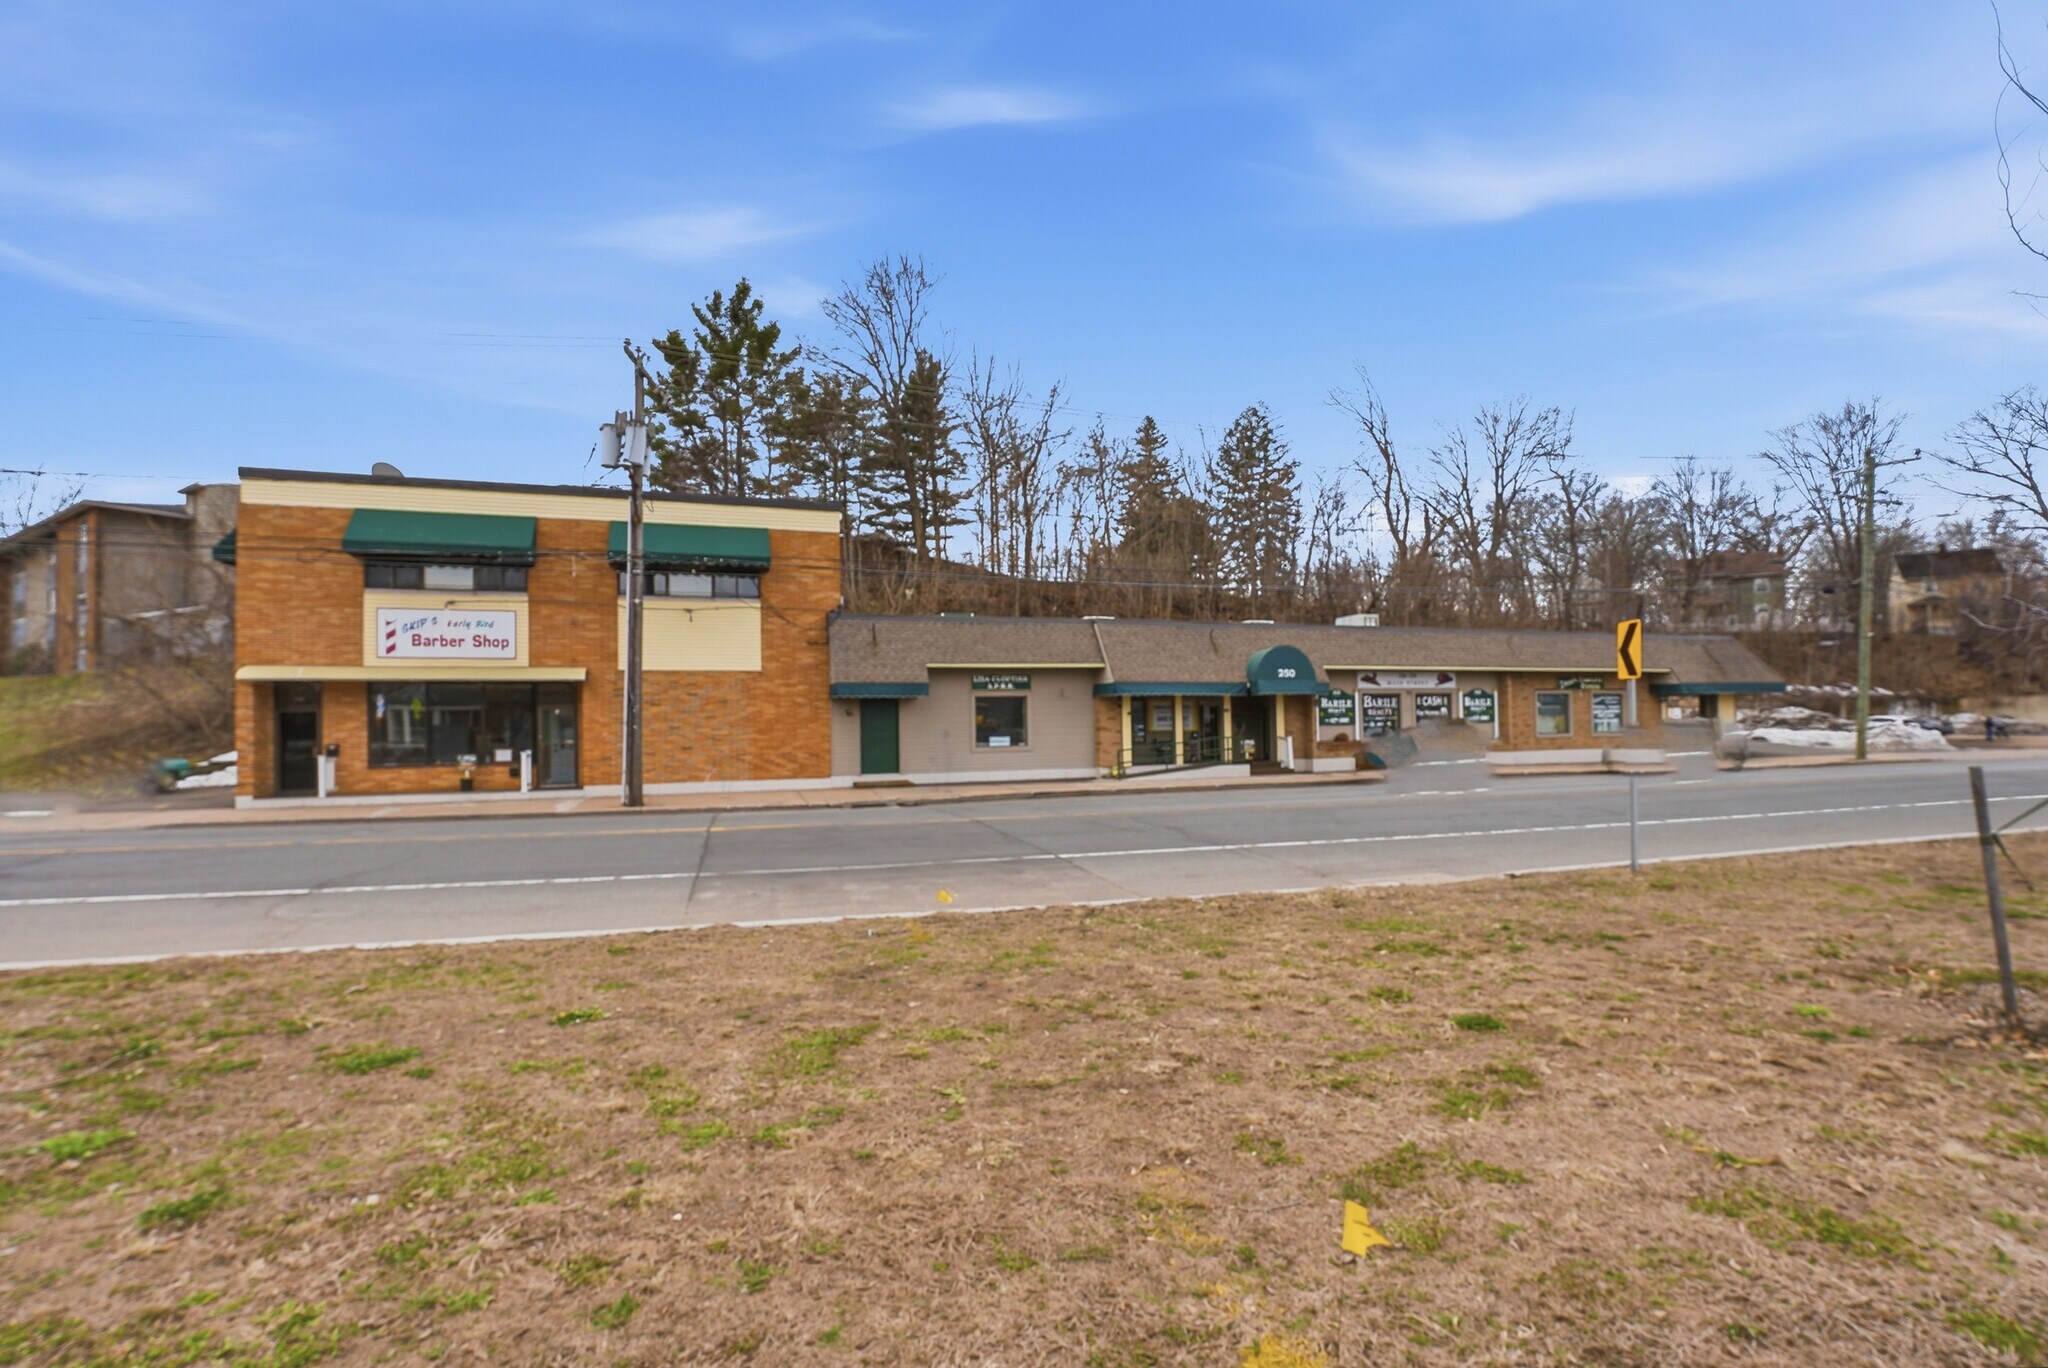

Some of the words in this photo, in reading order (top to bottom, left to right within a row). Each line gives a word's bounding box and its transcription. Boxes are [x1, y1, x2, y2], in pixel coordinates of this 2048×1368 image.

[447, 619, 471, 629] Early
[475, 620, 495, 629] Bird
[411, 633, 466, 648] Barber
[472, 634, 510, 651] Shop
[1277, 668, 1296, 678] 250
